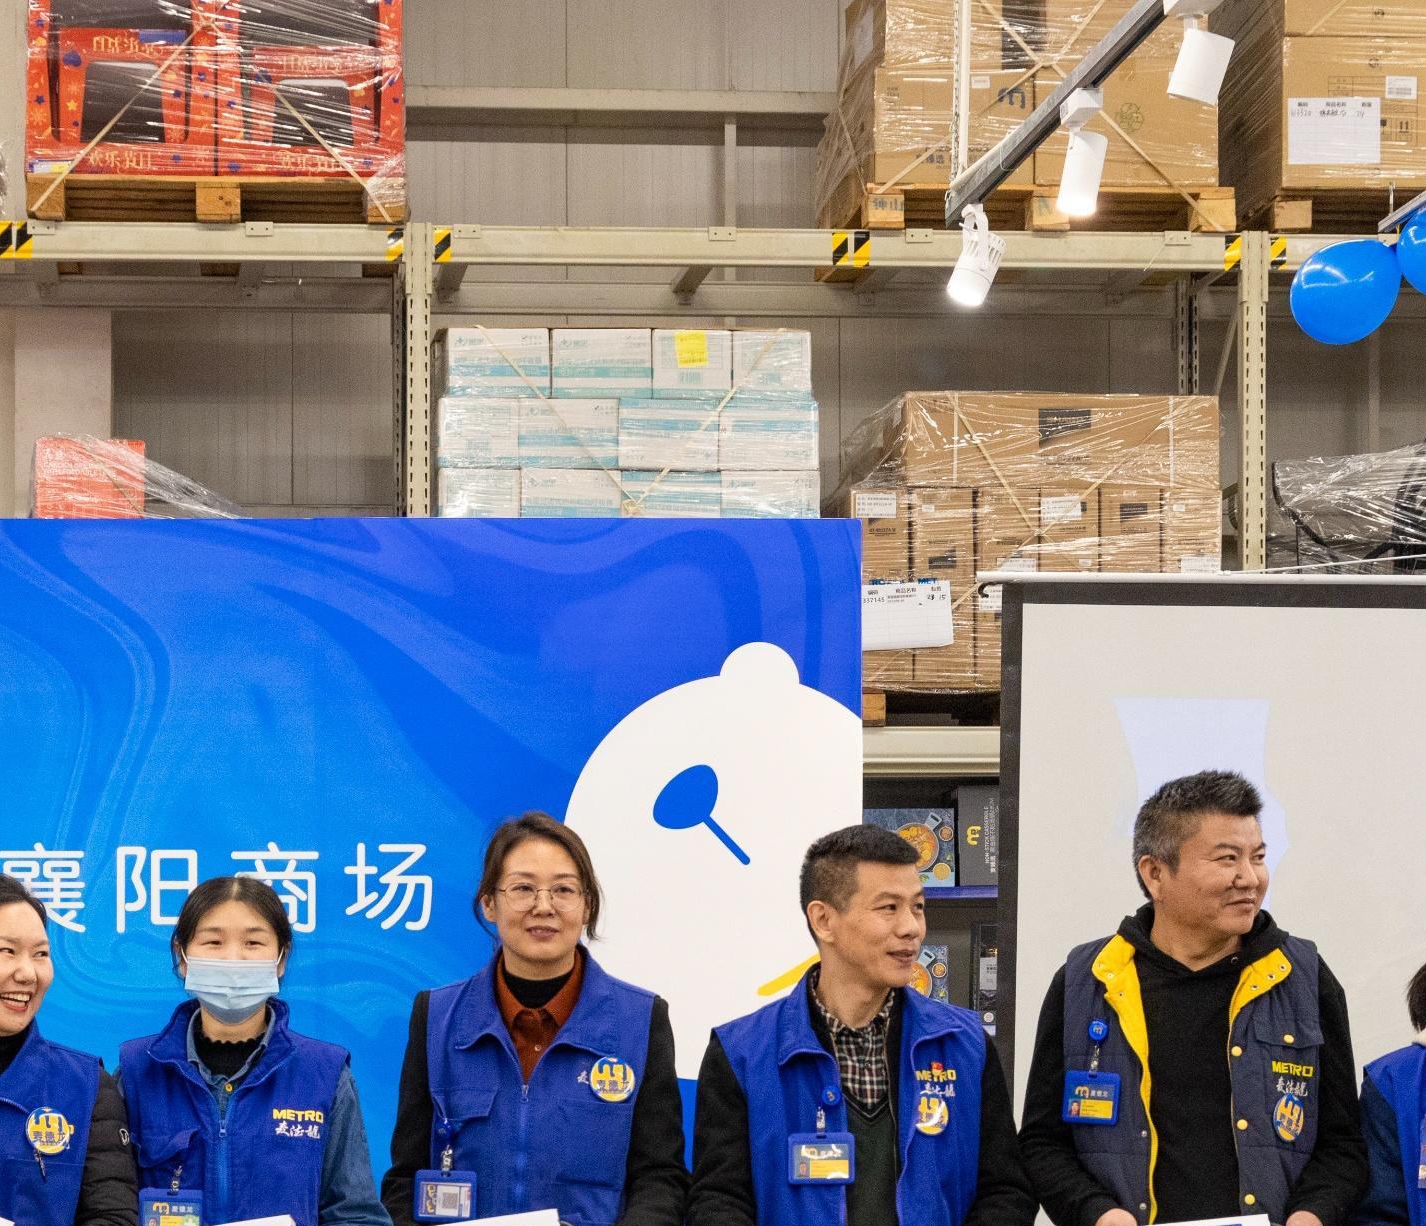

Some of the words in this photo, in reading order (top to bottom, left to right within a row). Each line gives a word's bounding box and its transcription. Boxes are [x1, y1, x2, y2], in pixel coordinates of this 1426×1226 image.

[916, 1068, 957, 1083] METRO
[1271, 1061, 1314, 1077] METRO
[273, 1109, 324, 1124] METRO
